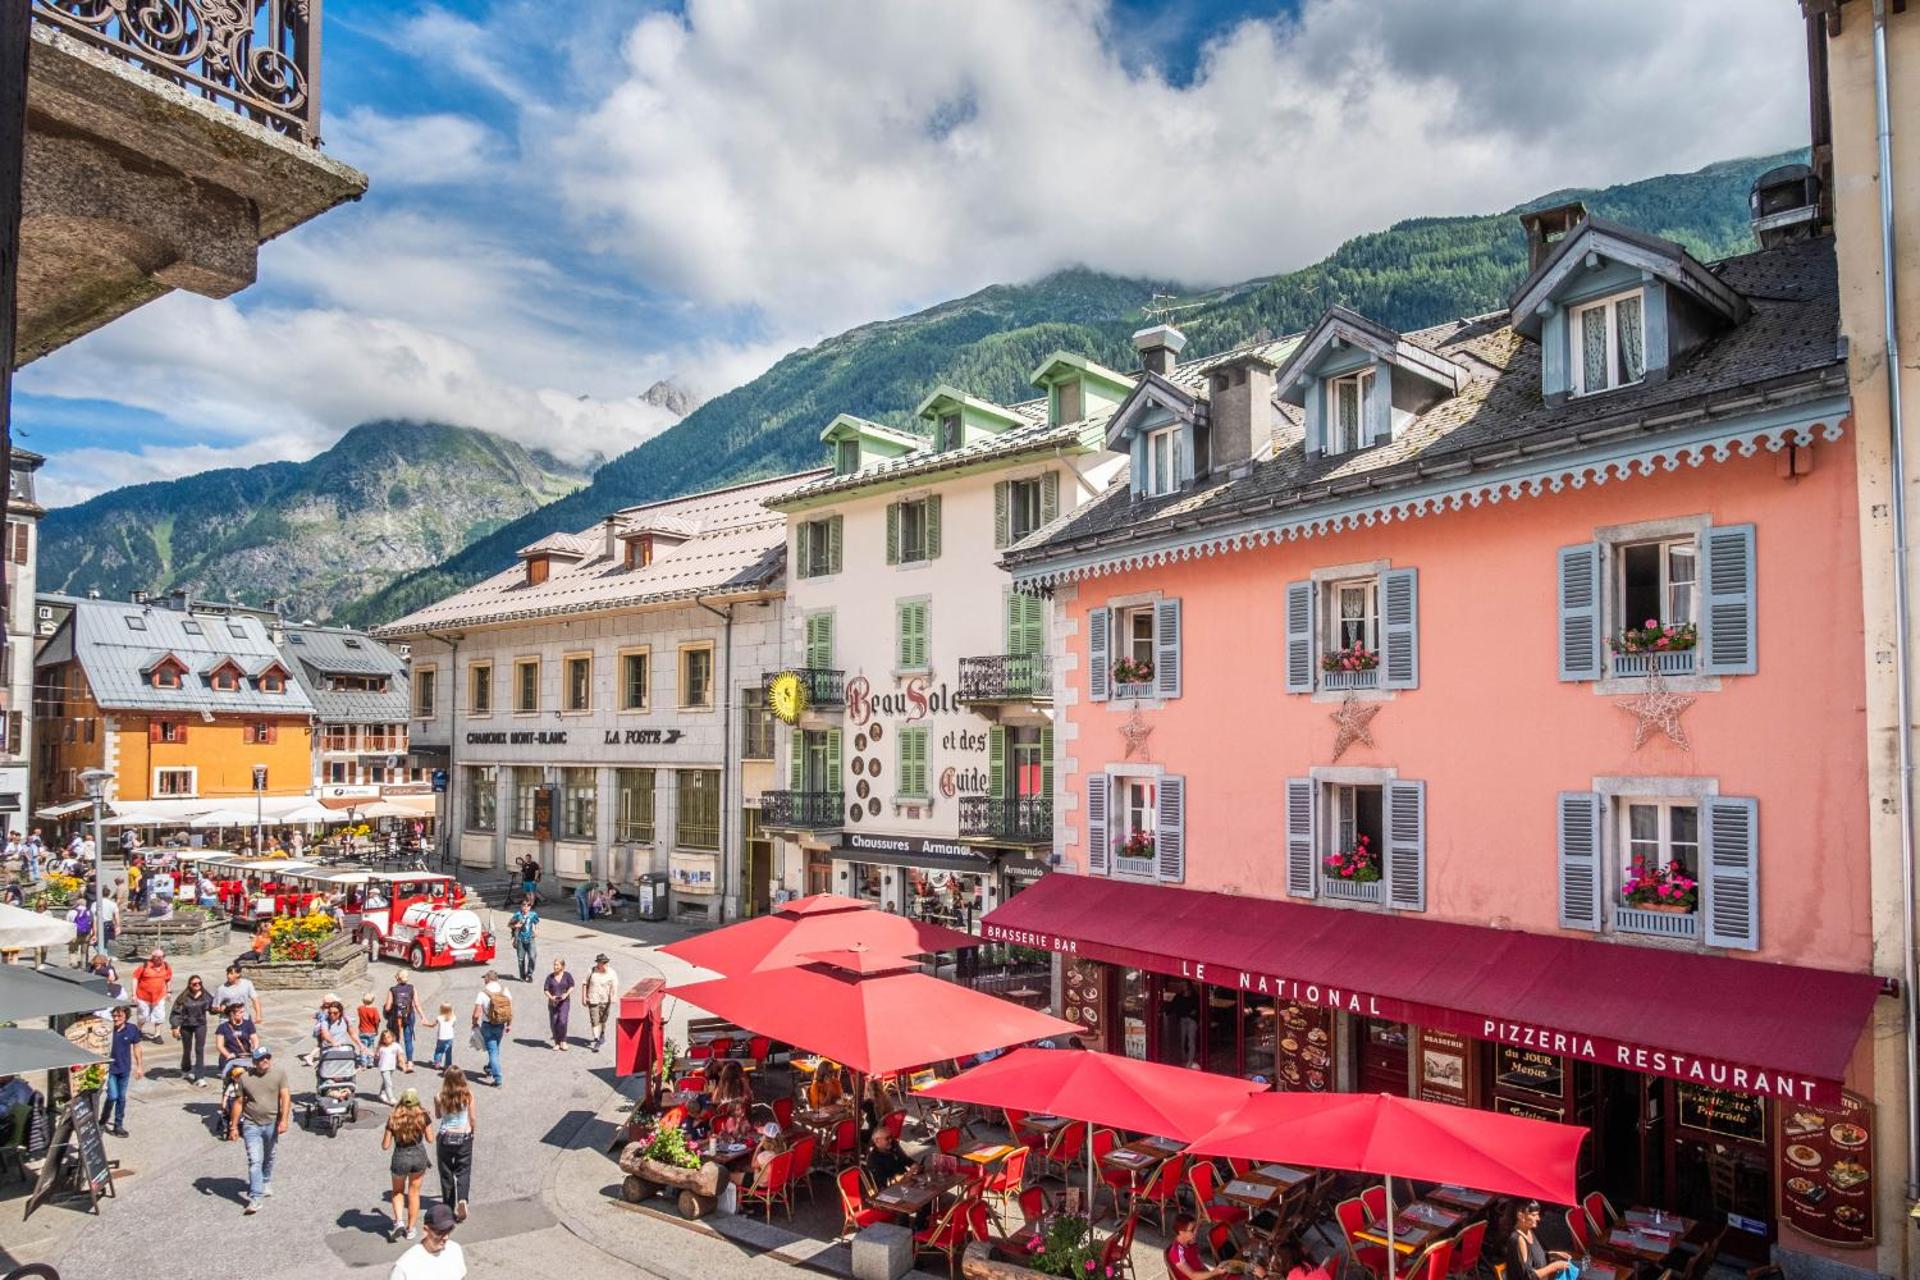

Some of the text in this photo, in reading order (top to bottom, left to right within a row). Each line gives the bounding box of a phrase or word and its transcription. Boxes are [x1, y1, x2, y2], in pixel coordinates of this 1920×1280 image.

[466, 731, 567, 745] CHAMONIX MONT-BLANC
[604, 730, 661, 745] LA POSTE
[943, 728, 987, 752] et des
[939, 766, 990, 798] Guide
[852, 834, 975, 856] Chaussures Armand
[1004, 864, 1044, 877] Armando
[987, 926, 1076, 953] BRASSERIE BAR
[1183, 961, 1380, 1015] LE NATIONAL
[1484, 1020, 1816, 1101] PIZZERIA RESTAURANT
[1505, 1048, 1553, 1066] du JOUR
[1511, 1062, 1548, 1078] Menus
